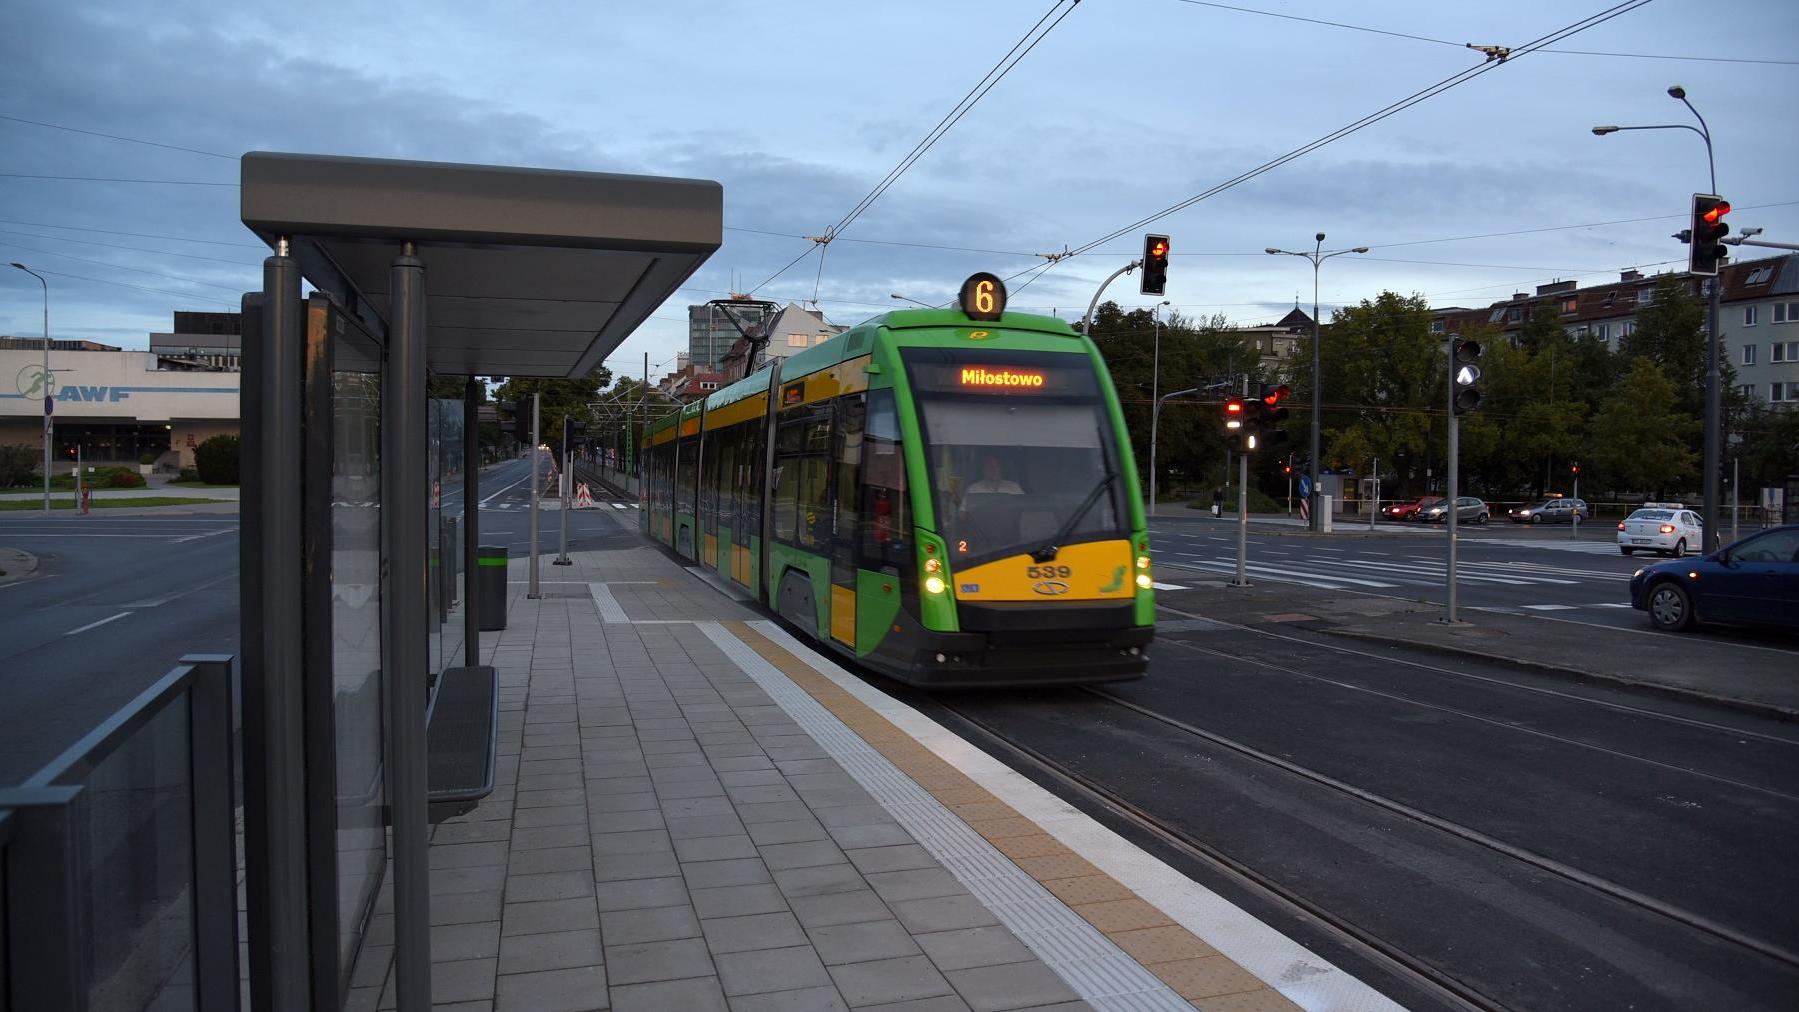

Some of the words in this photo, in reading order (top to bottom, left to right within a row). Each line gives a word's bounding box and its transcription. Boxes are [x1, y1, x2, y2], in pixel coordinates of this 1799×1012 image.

[976, 280, 994, 313] 6
[961, 369, 1043, 386] Miłostowo
[56, 386, 129, 402] AWF
[958, 541, 967, 552] 2
[1026, 565, 1072, 579] 539
